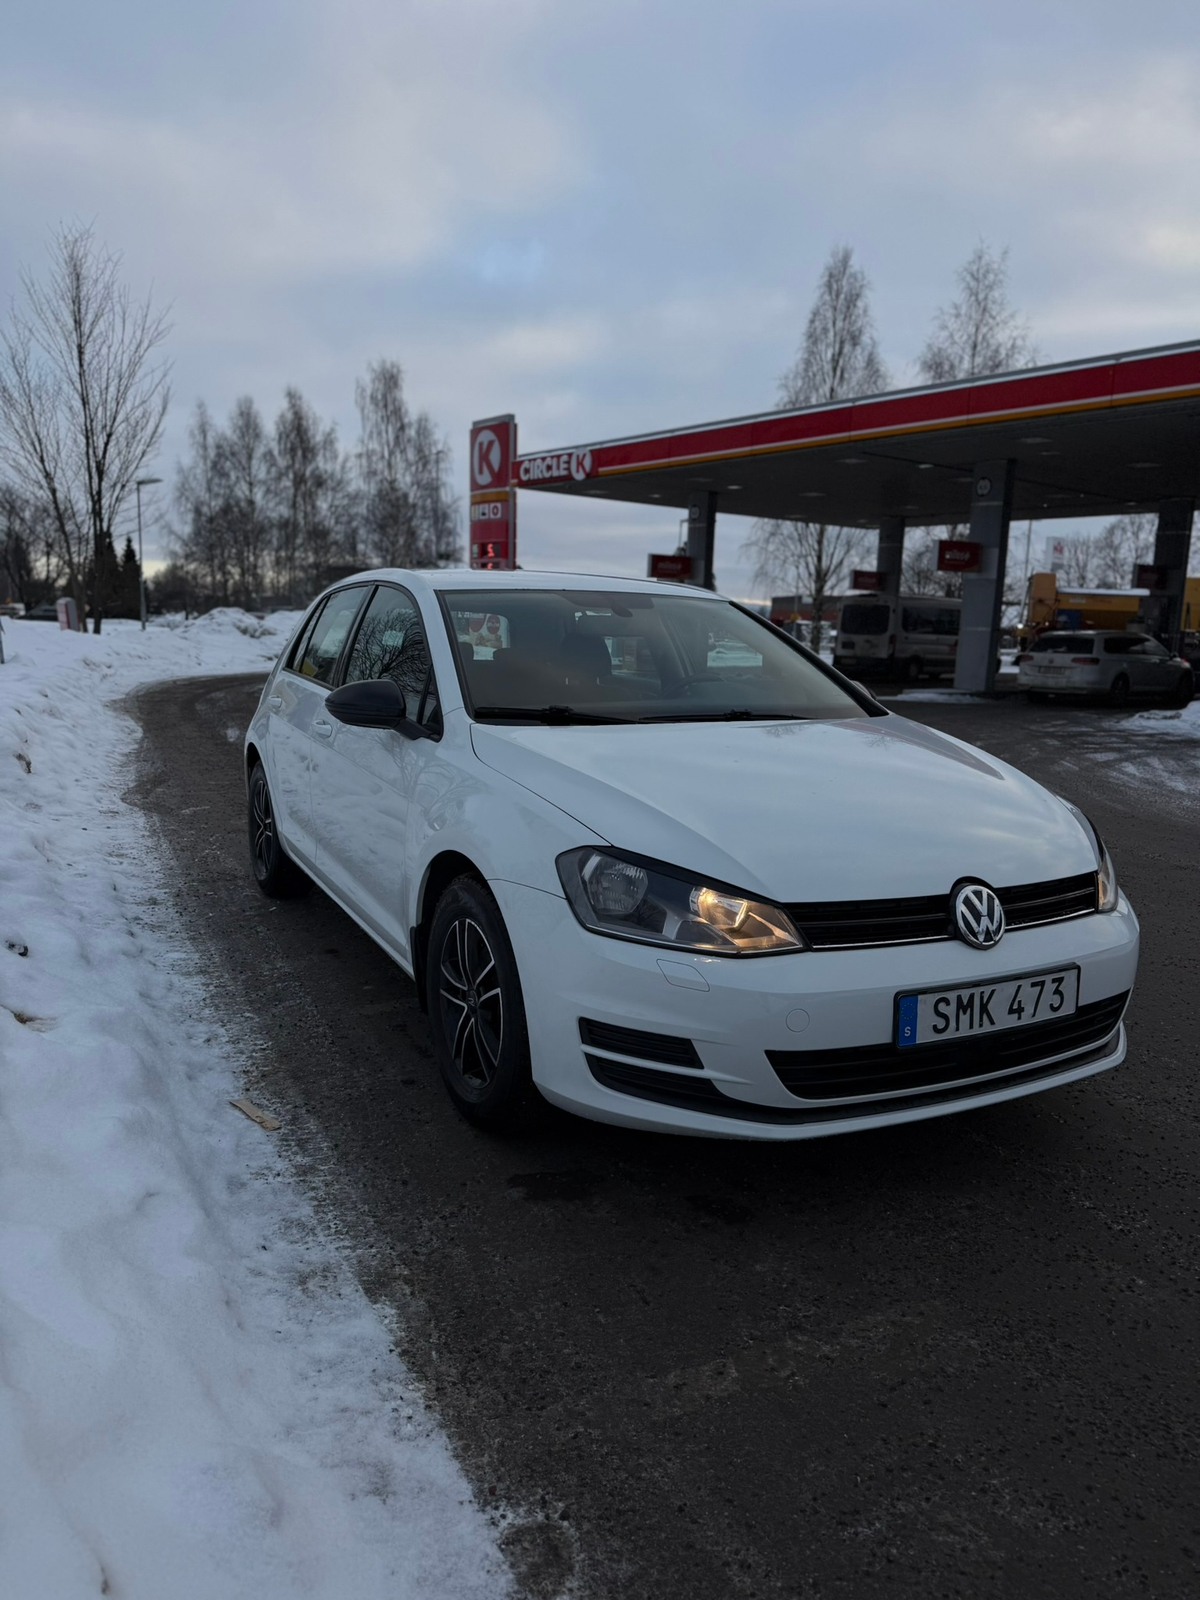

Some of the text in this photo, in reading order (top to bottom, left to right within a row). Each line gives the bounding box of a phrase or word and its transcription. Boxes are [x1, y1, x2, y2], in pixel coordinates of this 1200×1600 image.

[519, 455, 570, 481] CIRCLE
[932, 976, 1065, 1035] SMK 473
[904, 1026, 911, 1037] S
